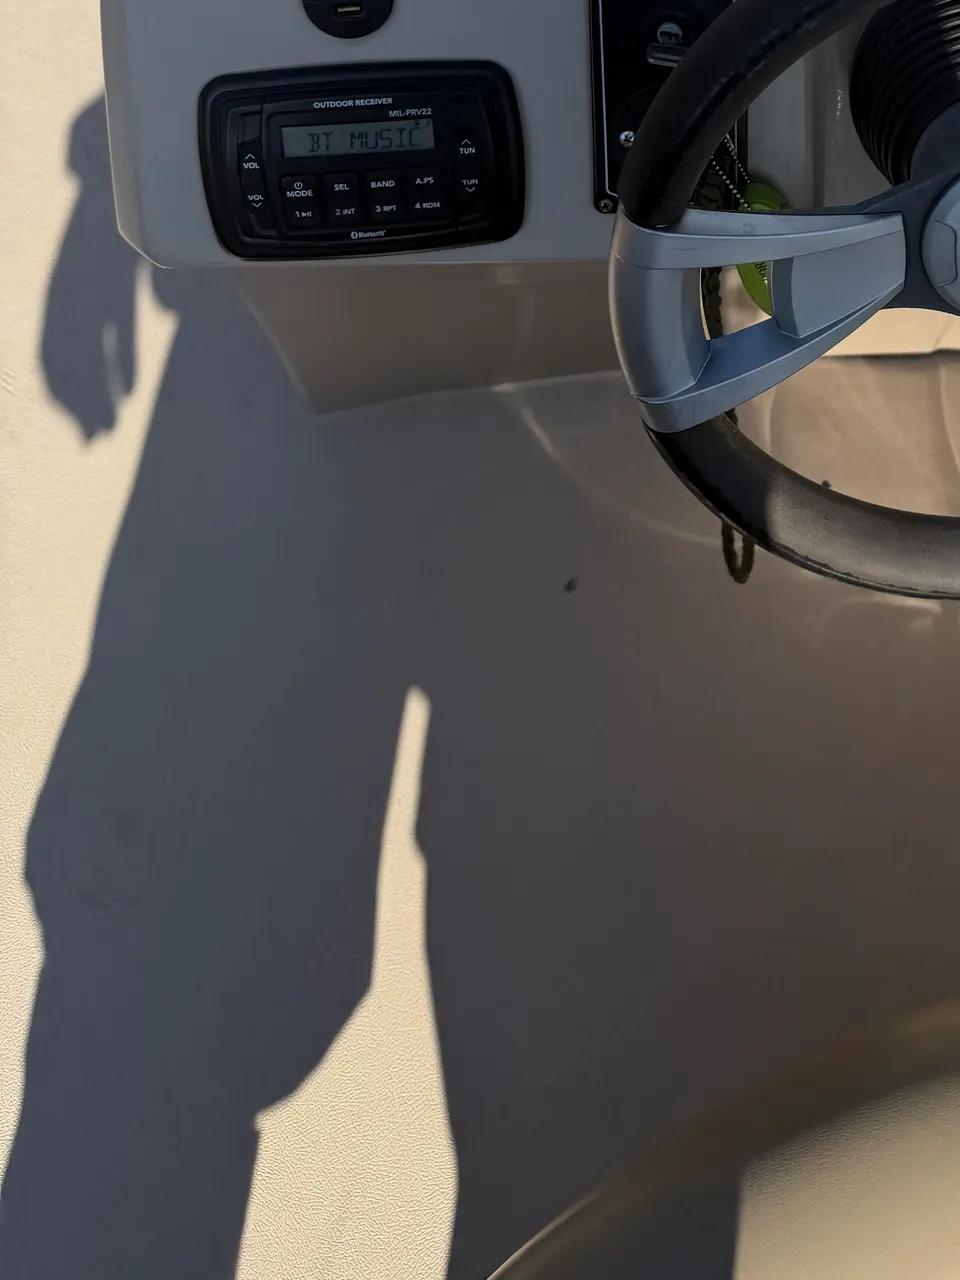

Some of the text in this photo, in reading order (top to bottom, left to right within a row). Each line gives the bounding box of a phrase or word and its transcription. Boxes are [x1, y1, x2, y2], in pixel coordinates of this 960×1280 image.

[313, 97, 393, 109] OUTDOOR RECEIVER
[389, 107, 433, 117] MIL-PRV22
[307, 127, 421, 153] BT MUSIC
[459, 146, 476, 154] TUN
[243, 161, 260, 169] VOL
[370, 179, 396, 188] BAND
[462, 178, 479, 186] TUN
[333, 183, 350, 191] SEL
[286, 189, 314, 198] MODE
[376, 205, 381, 213] 3
[422, 201, 441, 209] RDM
[335, 208, 356, 216] 2 INT
